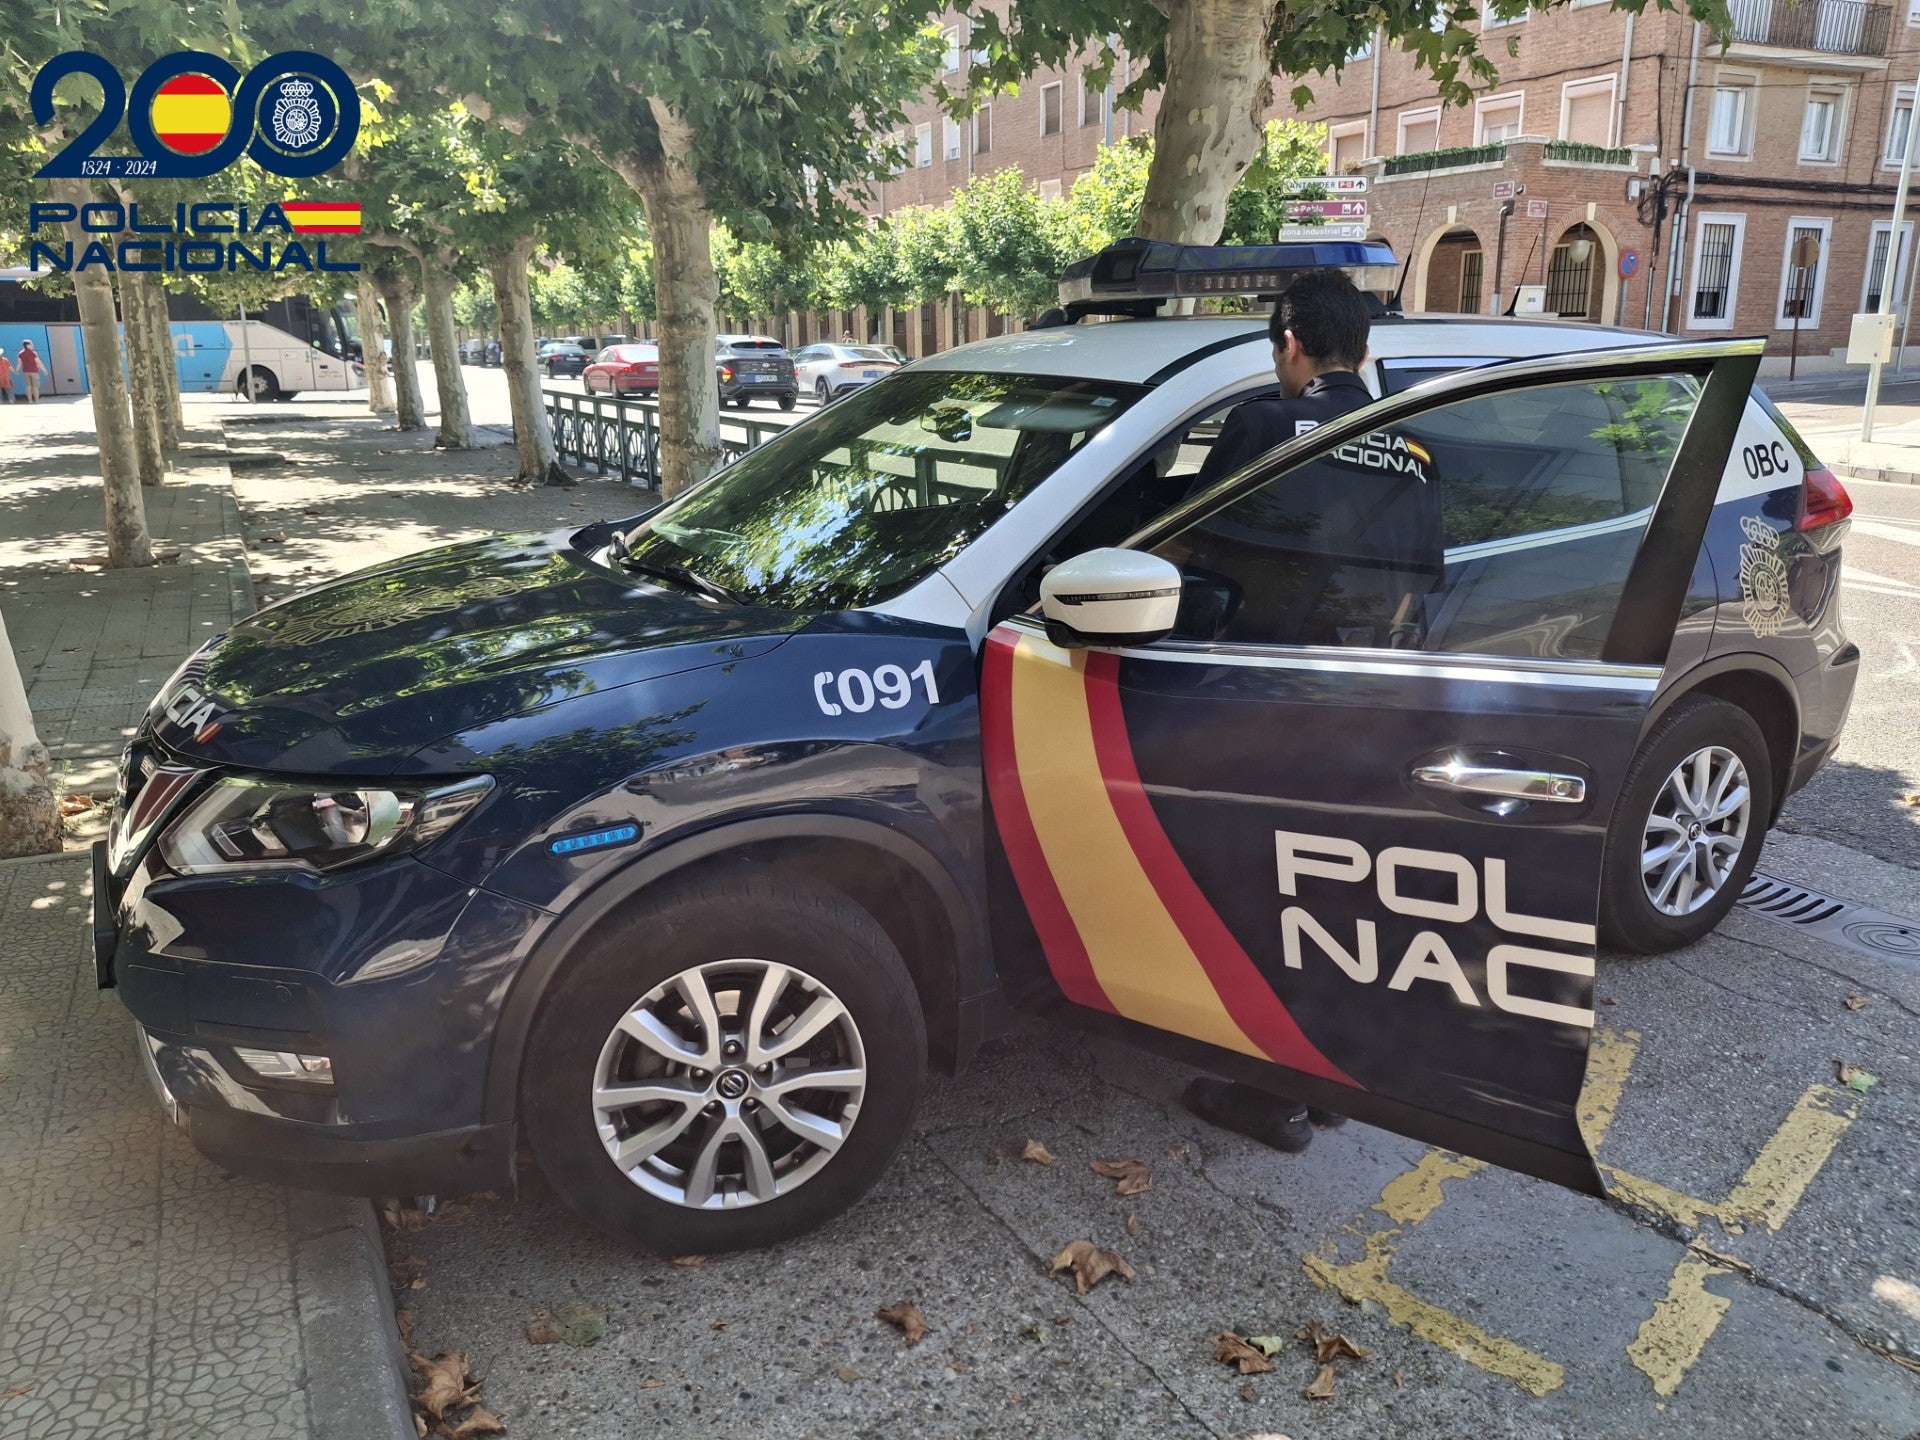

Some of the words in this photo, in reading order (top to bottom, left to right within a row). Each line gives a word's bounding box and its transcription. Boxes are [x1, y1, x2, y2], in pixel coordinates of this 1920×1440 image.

[1302, 227, 1341, 235] industrial
[1328, 445, 1428, 485] CIONAL
[837, 659, 940, 713] 091
[1275, 829, 1596, 945] POL
[1280, 906, 1596, 1028] NAC
